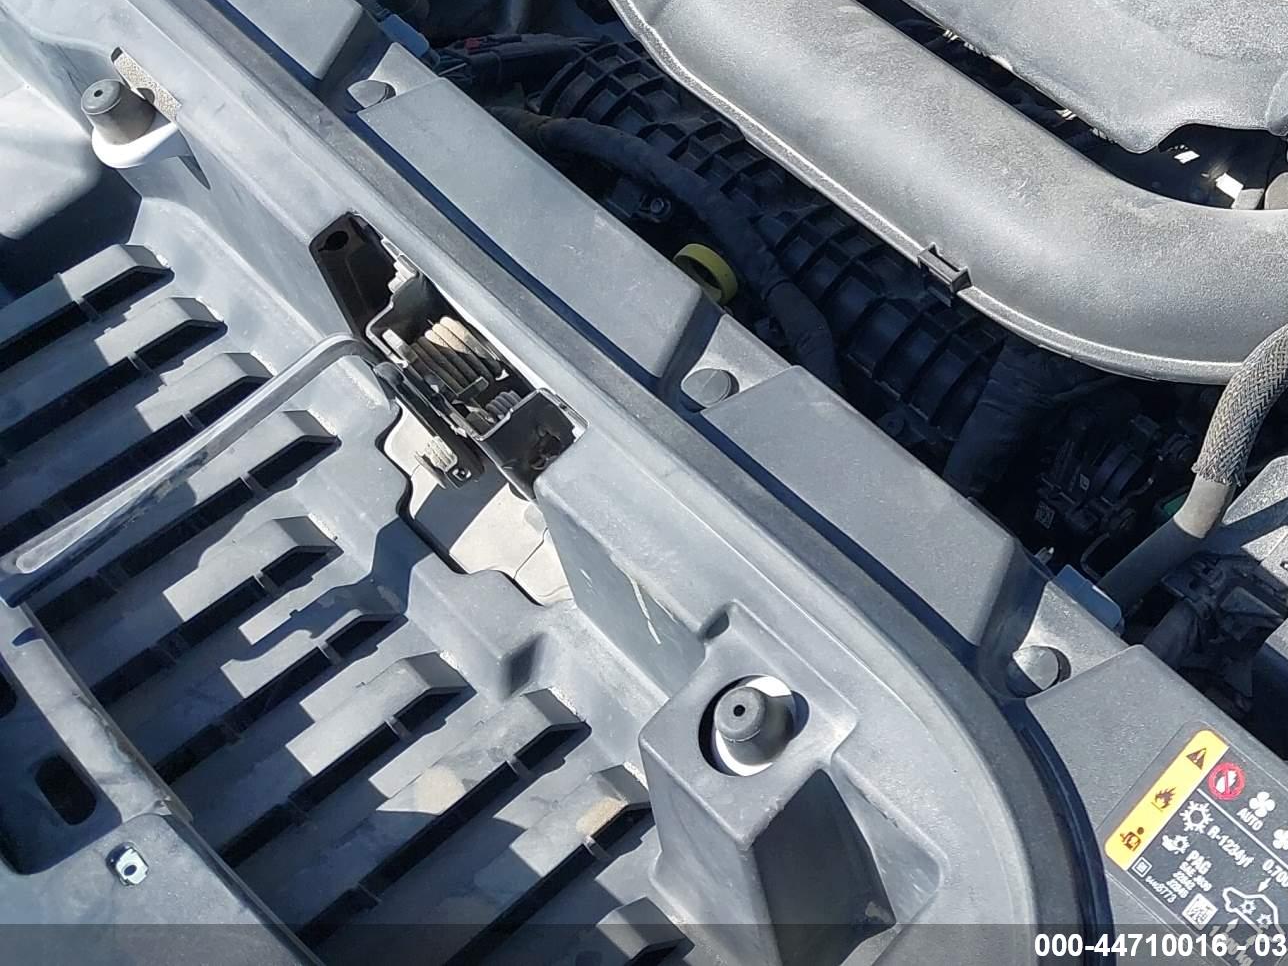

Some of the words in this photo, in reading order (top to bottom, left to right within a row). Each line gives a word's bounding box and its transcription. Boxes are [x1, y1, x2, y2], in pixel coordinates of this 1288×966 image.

[1237, 808, 1263, 831] AUTO
[1206, 825, 1255, 868] R-1234yf
[1185, 850, 1213, 876] PAG
